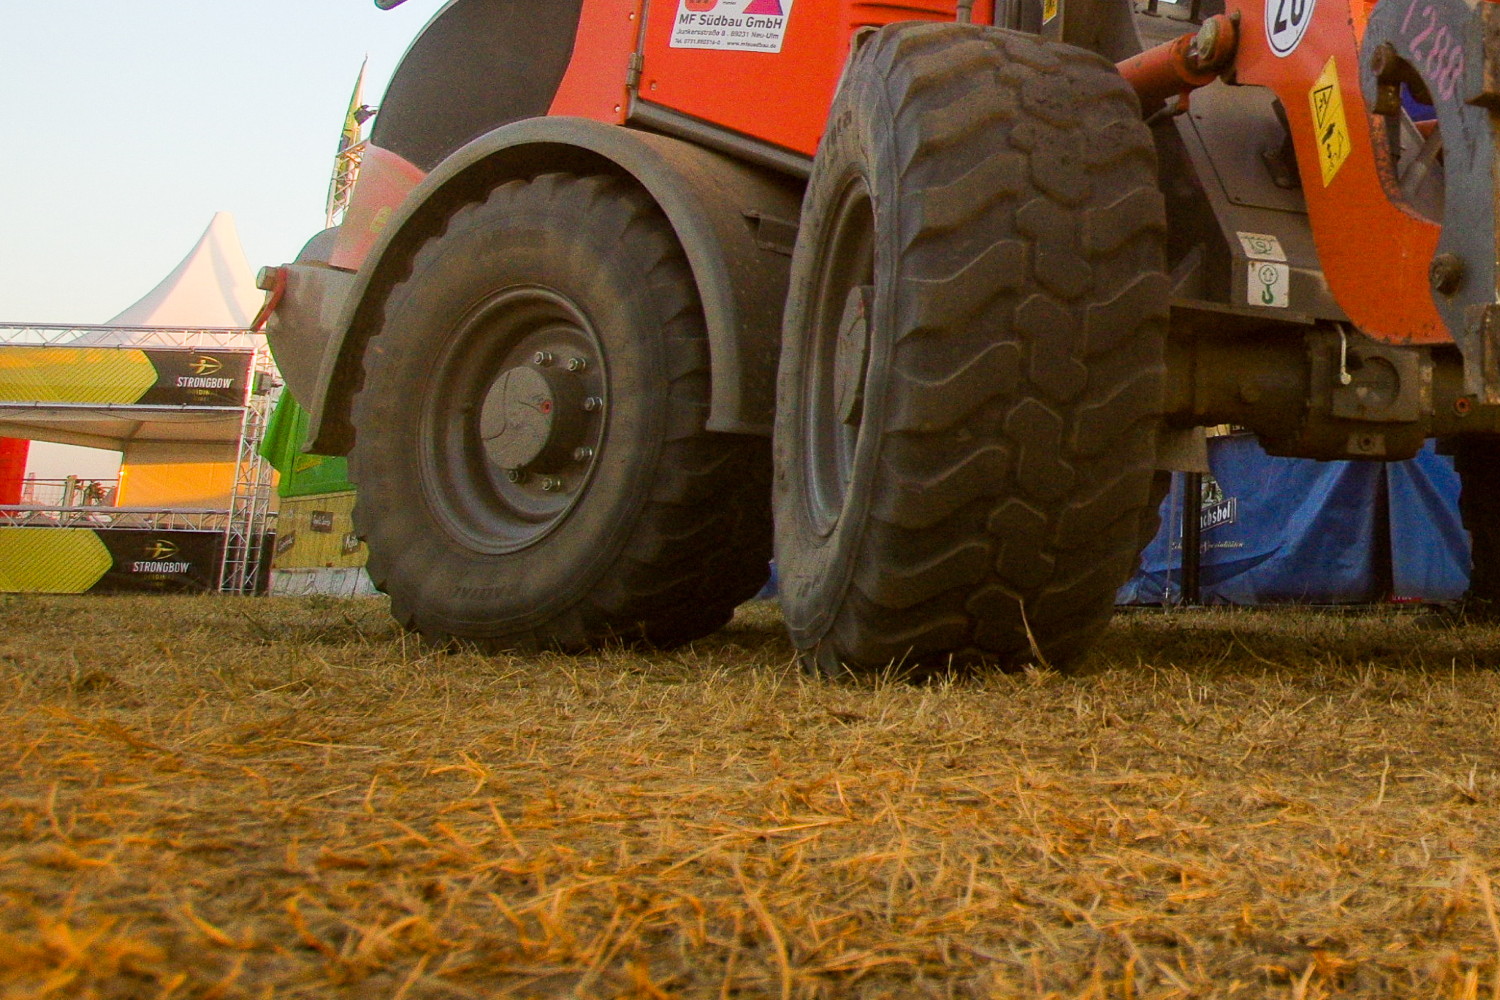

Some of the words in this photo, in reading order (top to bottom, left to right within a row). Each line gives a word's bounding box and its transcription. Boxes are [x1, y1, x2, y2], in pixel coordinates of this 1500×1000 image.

[679, 14, 697, 25] MF
[699, 14, 743, 27] Südbau
[745, 16, 783, 29] GmbH
[177, 376, 233, 389] STRONGBOW
[133, 561, 190, 573] STRONGBOW
